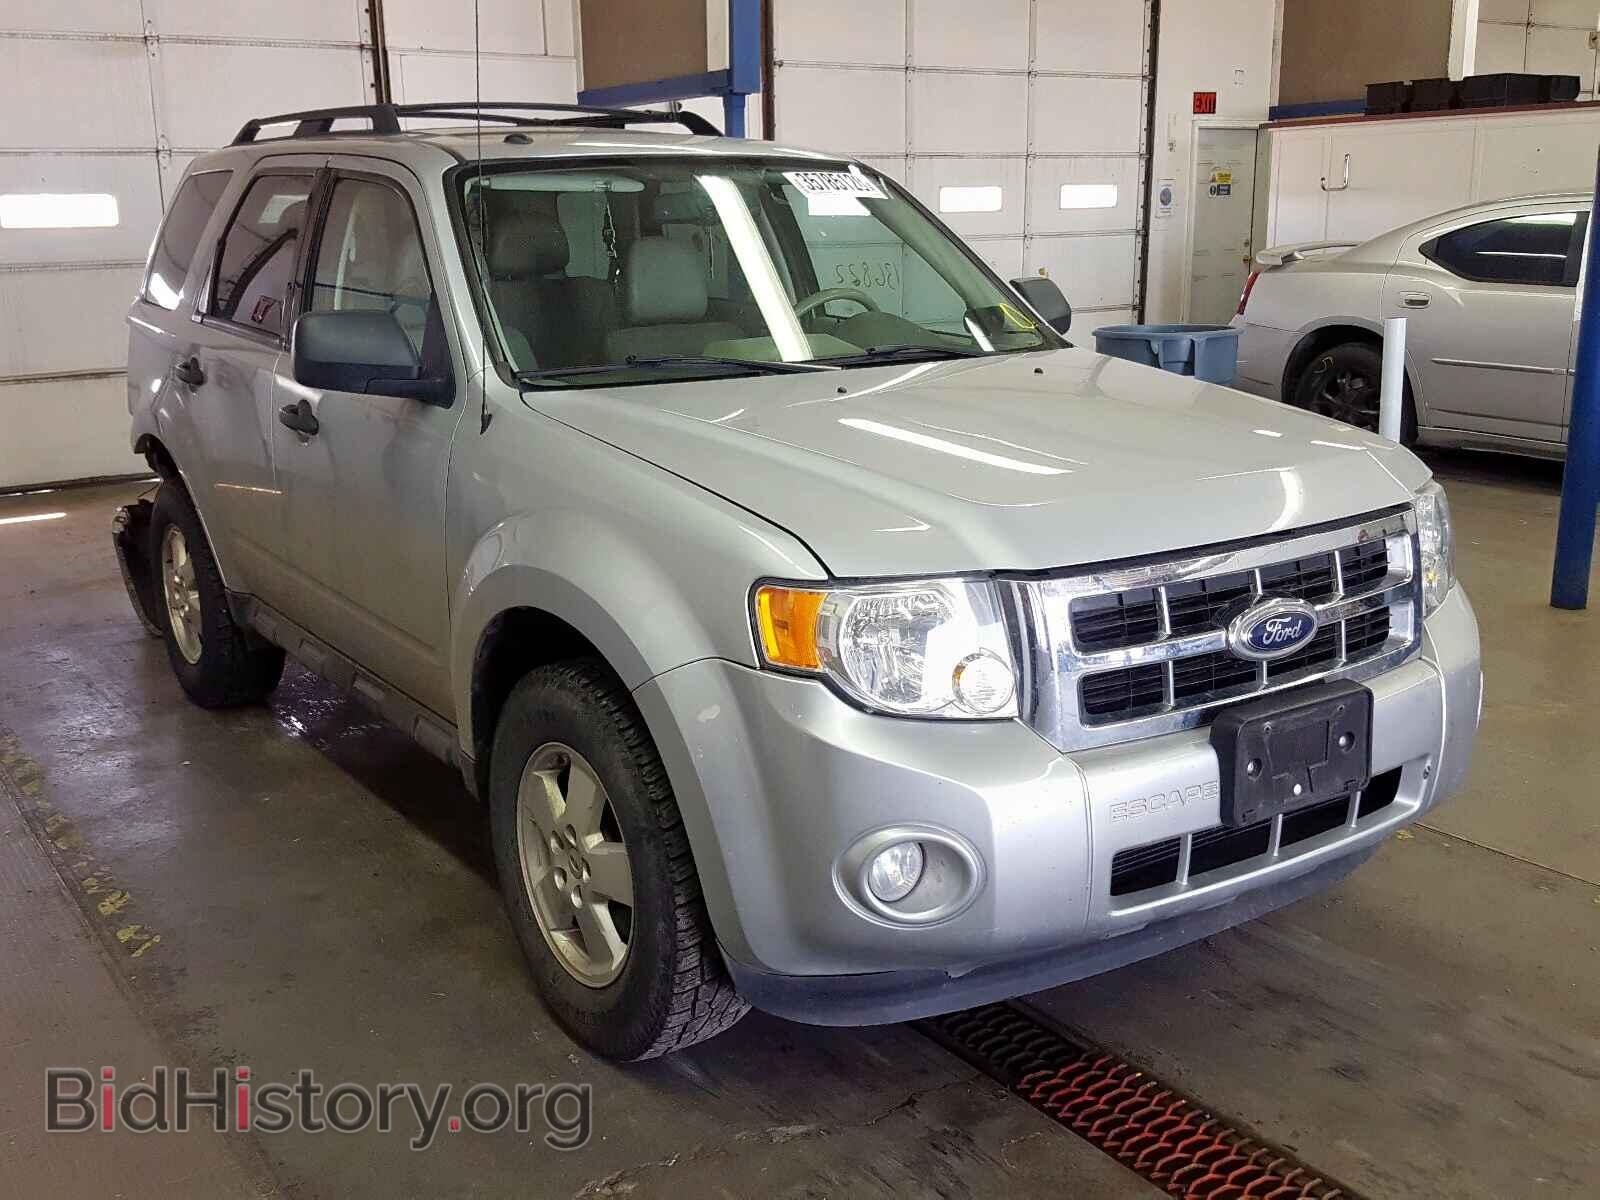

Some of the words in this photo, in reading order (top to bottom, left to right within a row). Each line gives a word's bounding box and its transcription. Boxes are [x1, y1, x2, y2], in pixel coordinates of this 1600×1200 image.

[1194, 93, 1215, 113] EXIT
[1262, 616, 1302, 645] Ford
[1109, 780, 1218, 823] ESCAPE
